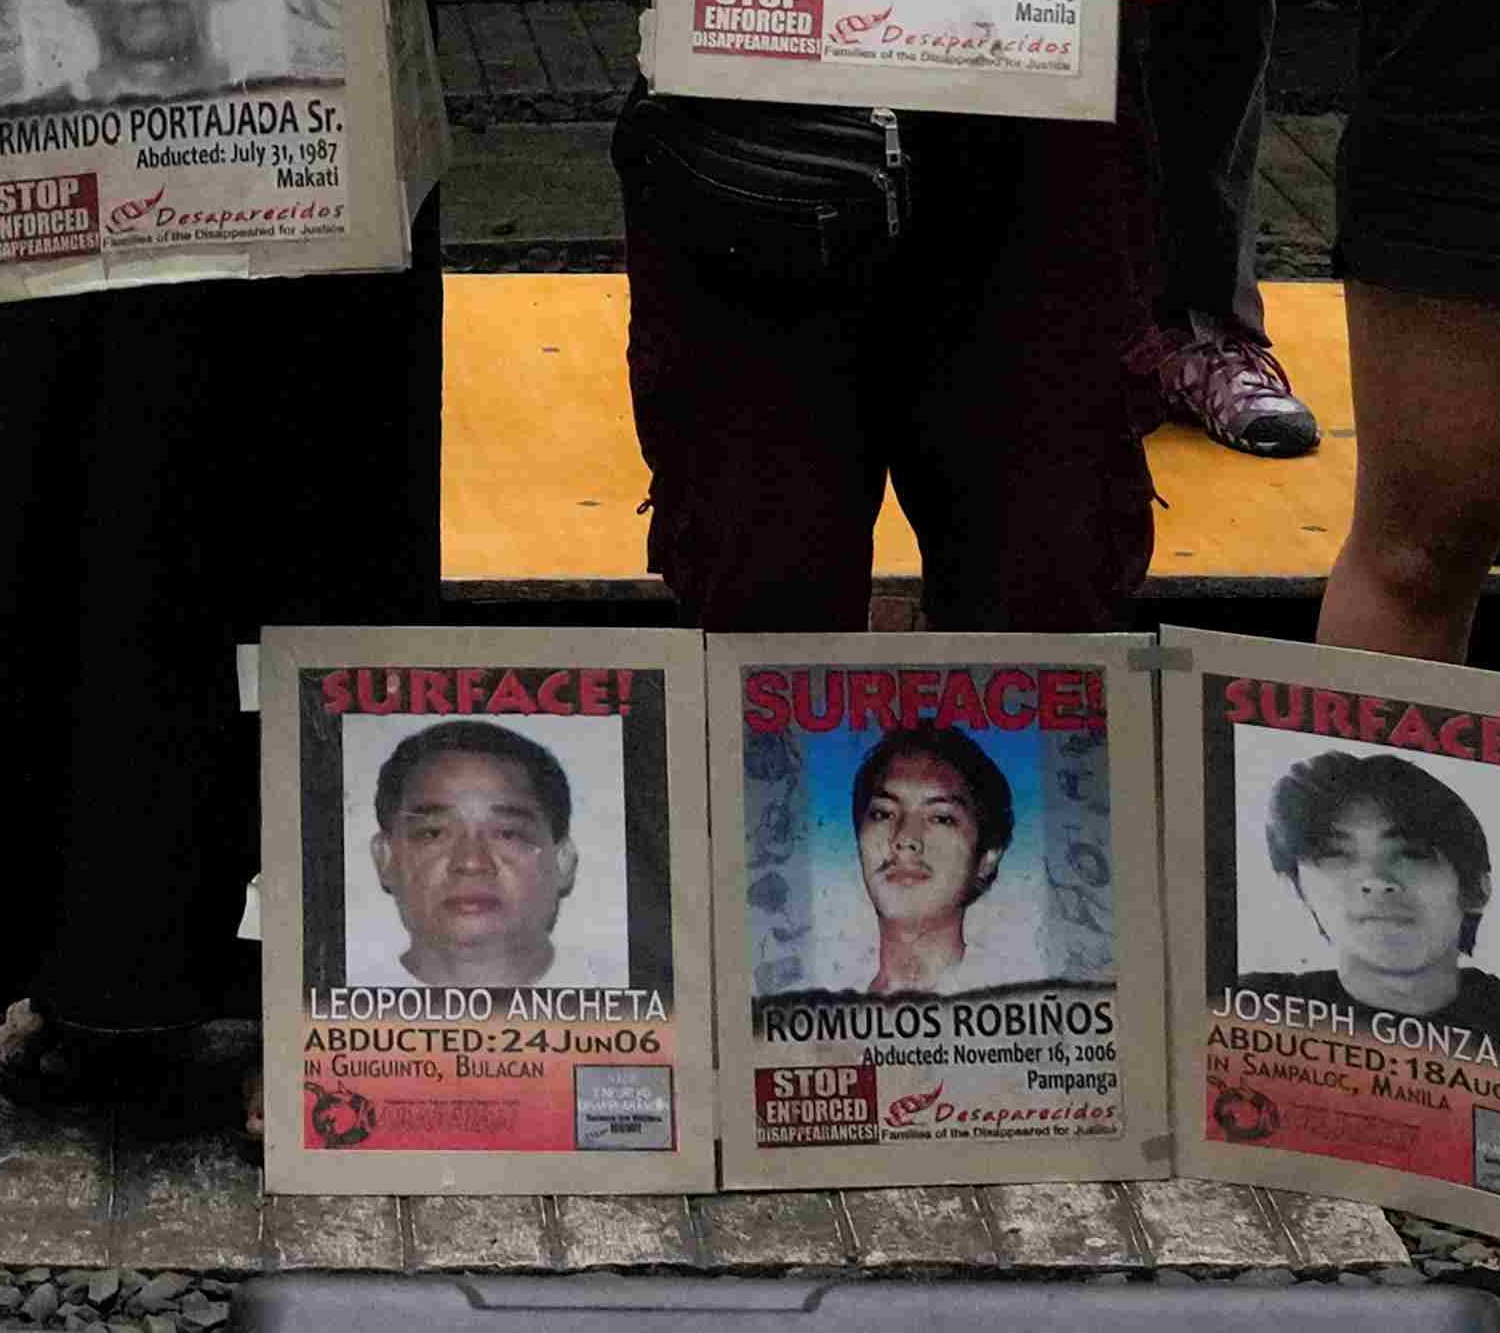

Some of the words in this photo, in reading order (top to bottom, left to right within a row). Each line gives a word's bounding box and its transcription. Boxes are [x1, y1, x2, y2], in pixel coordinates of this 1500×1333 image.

[704, 5, 813, 36] ENFORCED
[1014, 1, 1076, 26] Manila
[694, 30, 821, 55] DISAPPEARANCES!
[129, 100, 299, 143] PORTAJADA
[306, 99, 343, 134] Sr.
[135, 145, 227, 169] Abducted:
[229, 141, 266, 169] July
[271, 142, 294, 166] 31,
[299, 137, 338, 164] 1987
[276, 166, 340, 189] Makati
[155, 201, 344, 230] Desaparecidos
[322, 666, 634, 716] SURFACE!
[741, 665, 1109, 733] SURFACE!
[310, 987, 493, 1023] LEOPOLDO
[506, 987, 669, 1022] ANCHETA
[764, 1002, 942, 1043] ROMULOS
[952, 994, 1114, 1038] ROBIÑOS
[1212, 987, 1354, 1036] JOSEPH
[455, 1057, 545, 1079] BULACAN
[862, 1045, 949, 1067] Abducted:
[953, 1044, 1041, 1066] November
[1048, 1045, 1071, 1066] 16,
[1074, 1042, 1116, 1063] 2006
[773, 1067, 858, 1099] STOP
[1026, 1070, 1118, 1095] Pampanga
[766, 1096, 868, 1124] ENFORCED
[934, 1102, 1116, 1130] Desaparecidos
[757, 1122, 878, 1144] DISAPPEARANCES!
